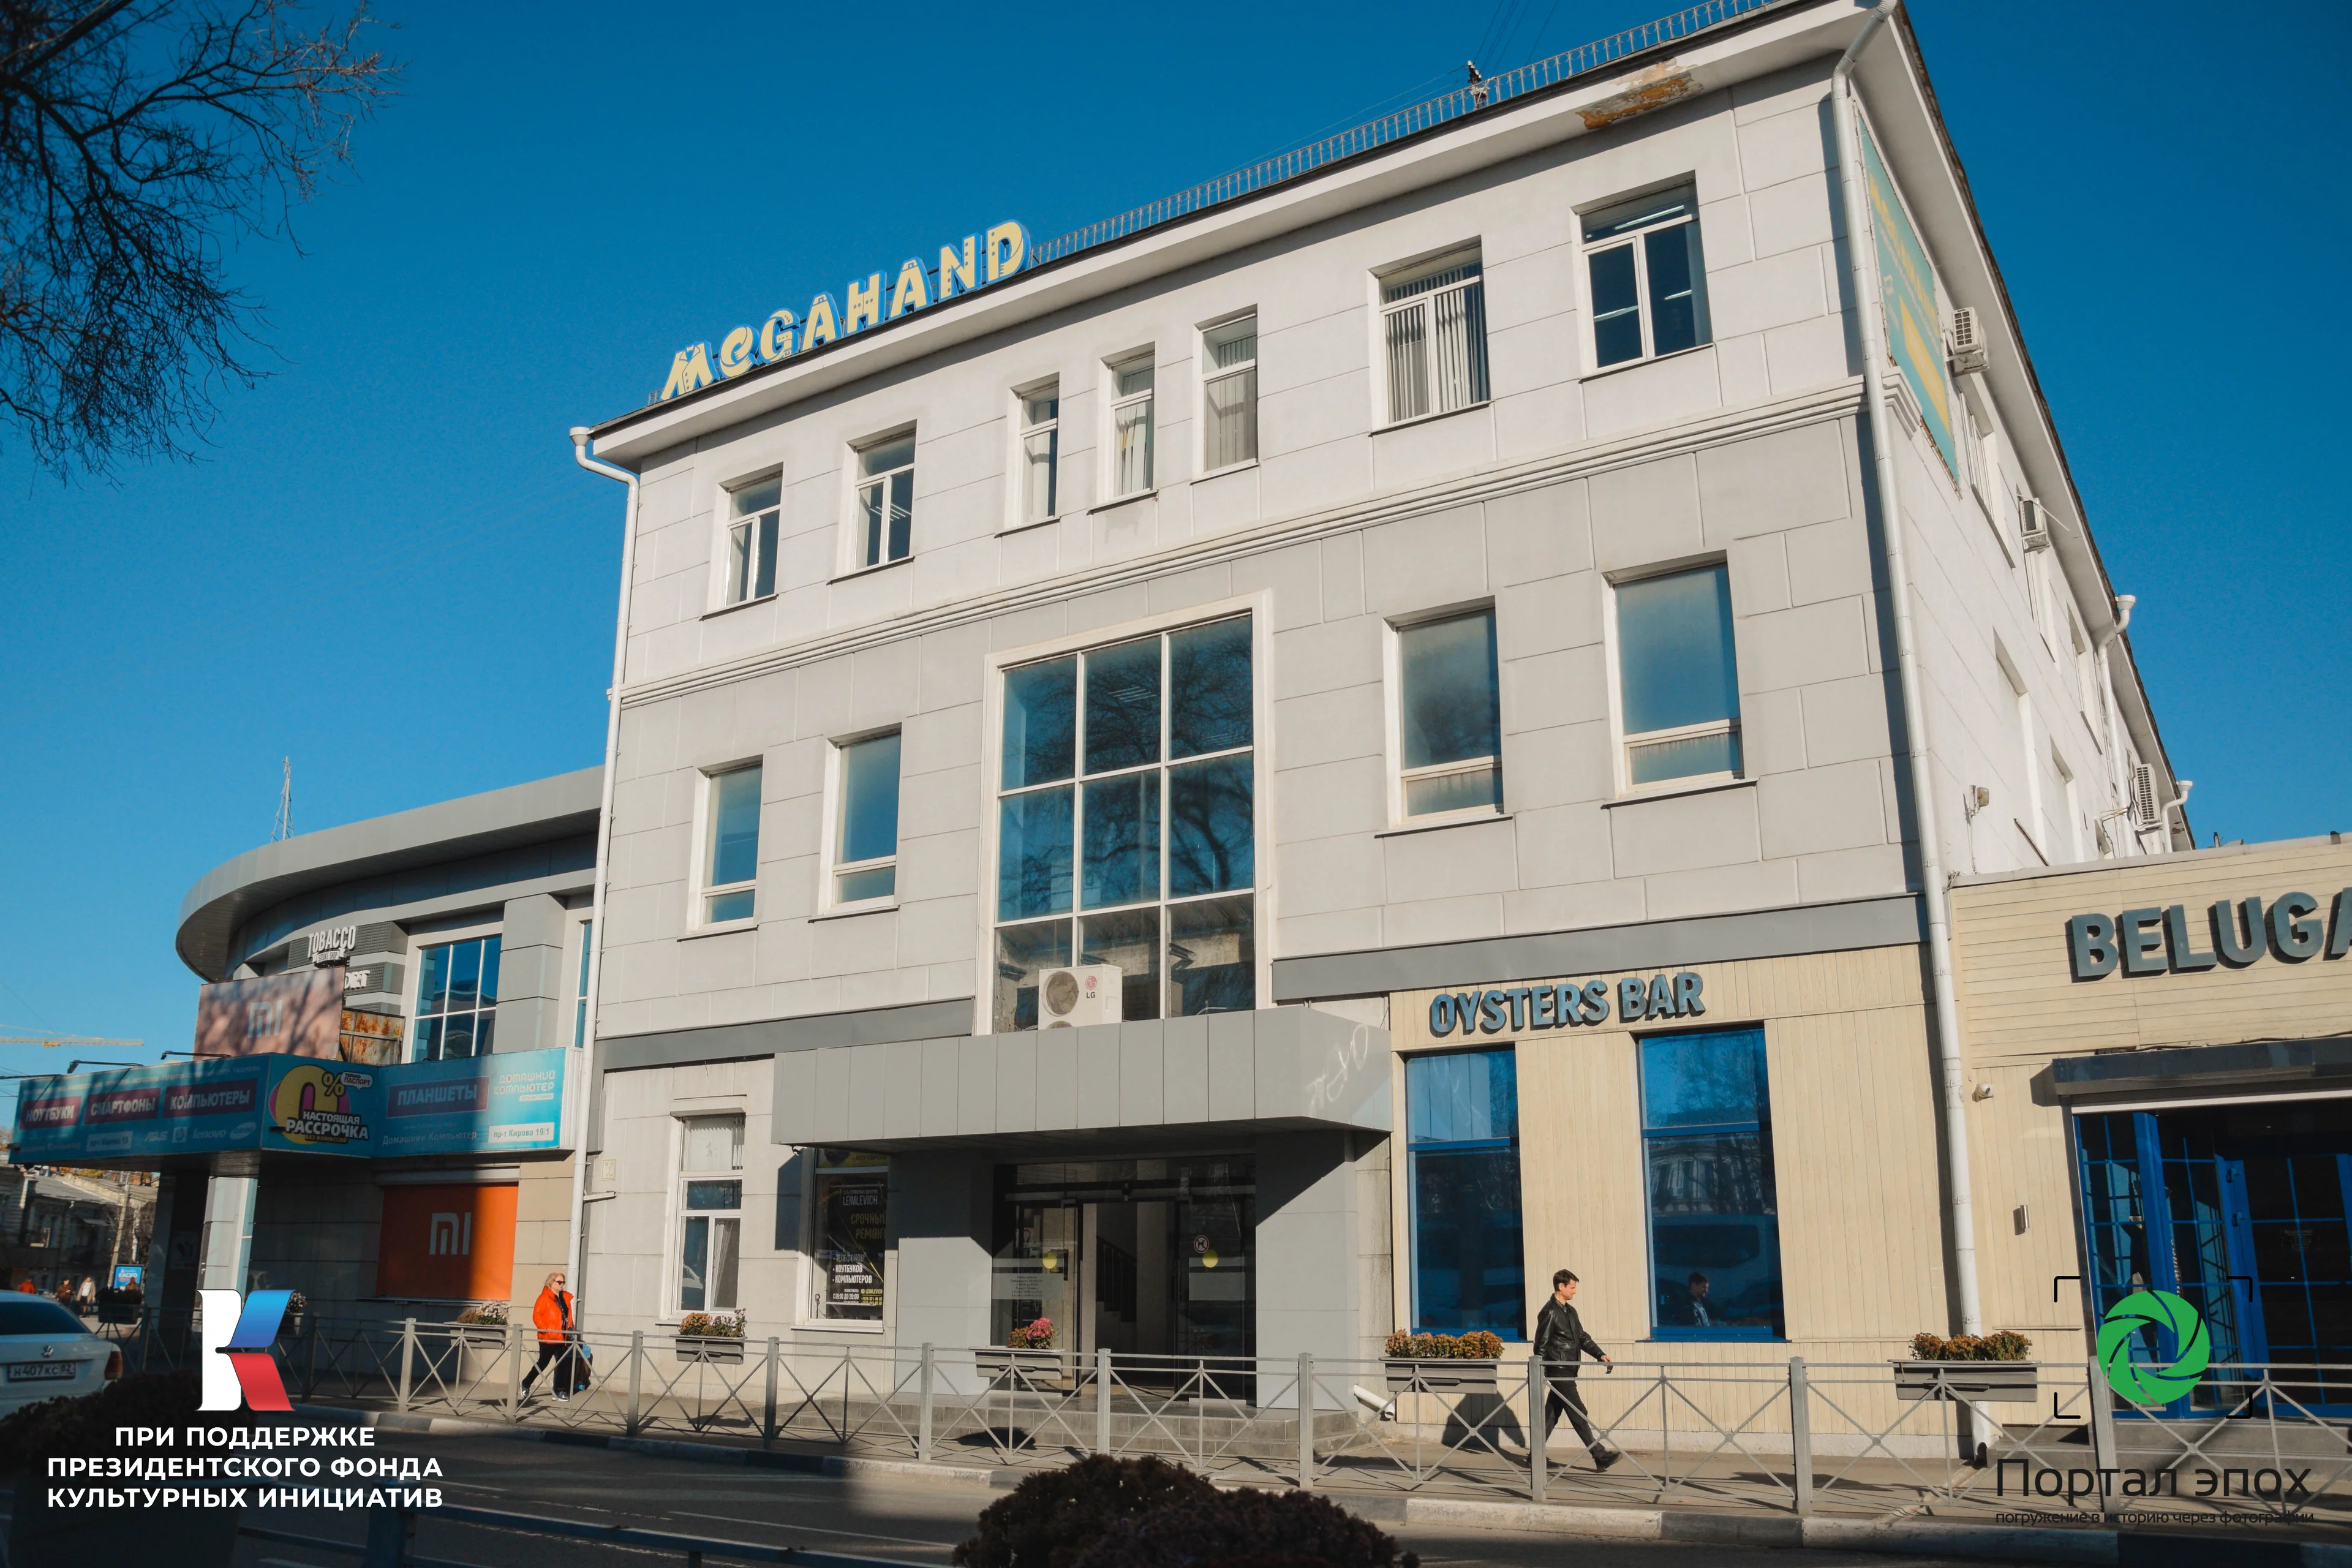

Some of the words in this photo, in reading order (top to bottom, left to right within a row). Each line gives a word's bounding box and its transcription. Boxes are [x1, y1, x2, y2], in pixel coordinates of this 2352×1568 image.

[307, 925, 356, 957] TOBACCO
[1430, 979, 1610, 1035] OYSTERS
[1621, 971, 1706, 1021] BAR
[170, 1090, 251, 1110] КОМПЬЮТЕРЫ
[398, 1084, 478, 1106] ПЛАНШЕТЫ
[25, 1105, 75, 1122] НОУТБУКИ
[91, 1098, 156, 1116] СМАРТФОНЫ
[303, 1110, 360, 1125] НАСТОЯЩАЯ
[285, 1119, 369, 1140] РАССРОЧКА
[429, 1131, 477, 1142] Компьютер
[508, 1129, 533, 1139] Кирова
[536, 1127, 549, 1136] 19/1
[843, 1195, 878, 1205] LEIMLEVICH
[835, 1264, 863, 1273] НОУТБУКОВ
[835, 1275, 872, 1284] КОМПЬЮТЕРОВ
